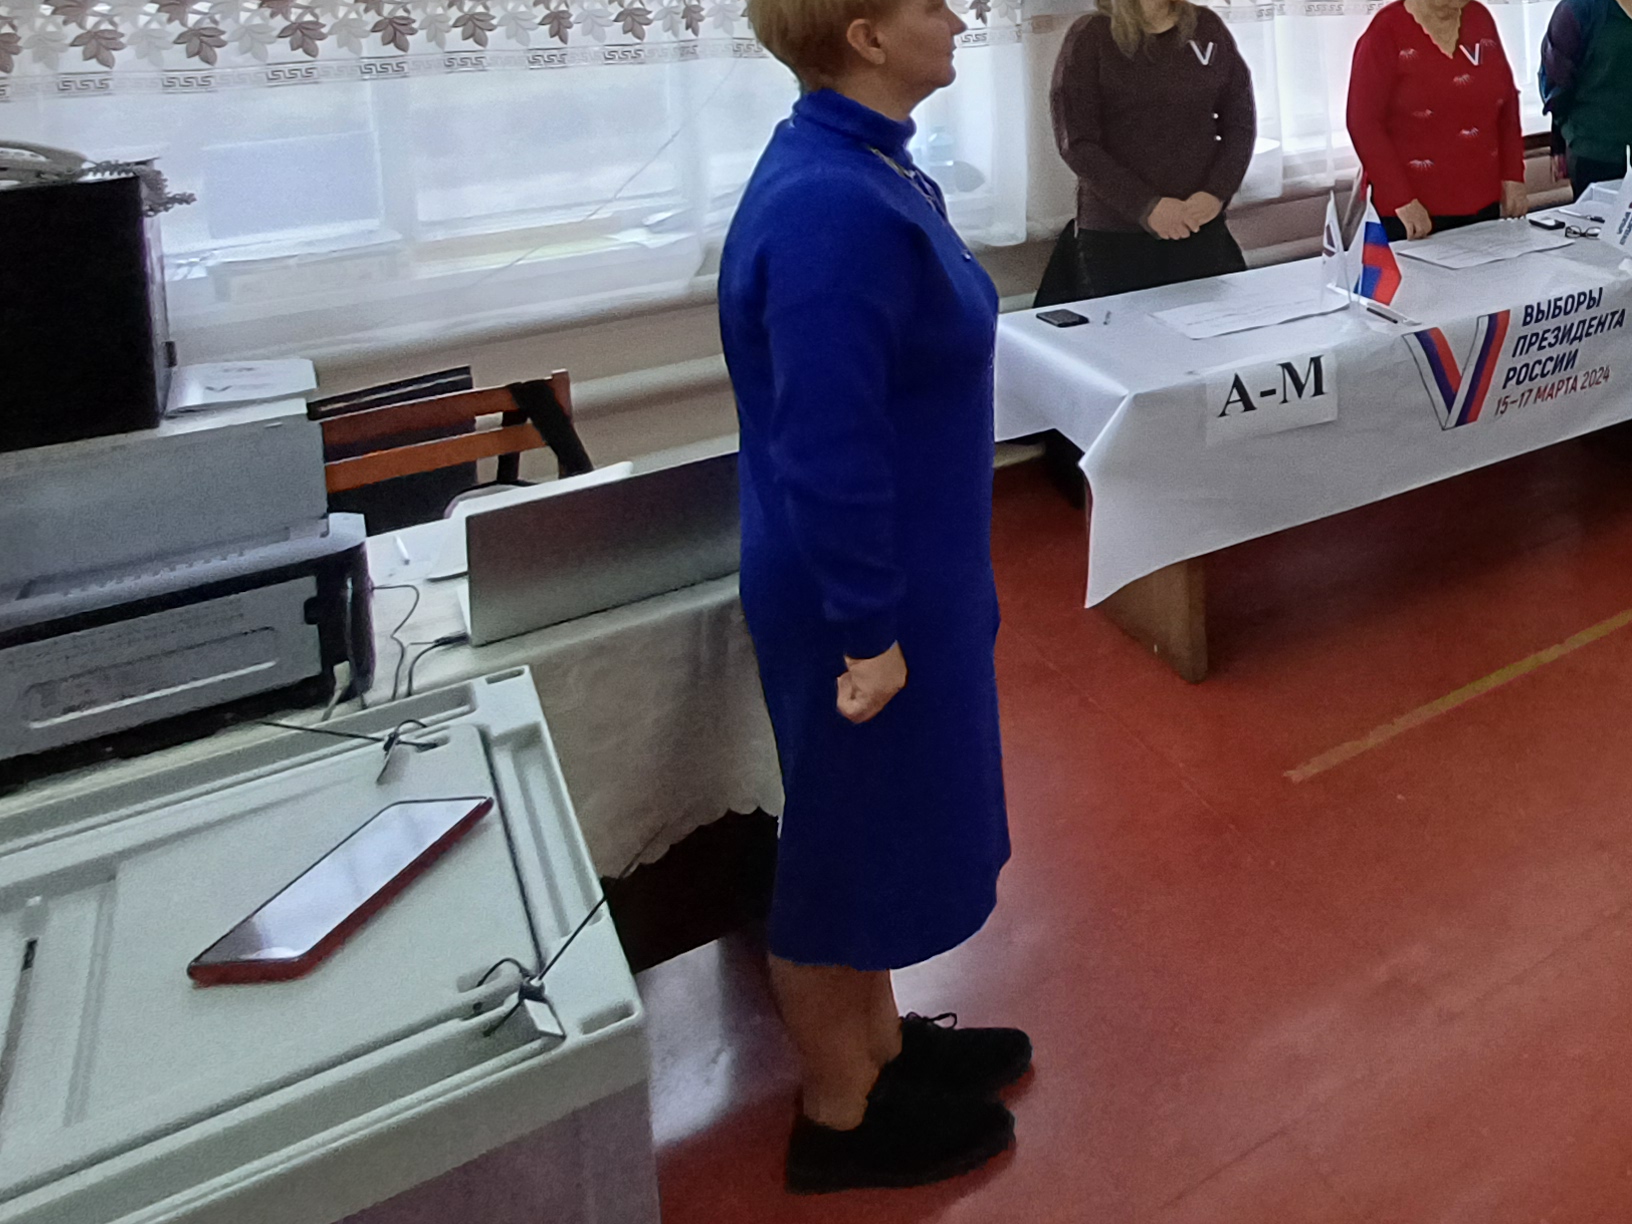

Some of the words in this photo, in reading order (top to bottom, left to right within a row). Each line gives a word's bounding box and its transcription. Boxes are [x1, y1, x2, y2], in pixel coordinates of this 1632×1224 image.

[1522, 287, 1604, 327] ВЫБОРЫ
[1511, 308, 1627, 358] ПРЕЗИДЕНТА
[1217, 354, 1327, 418] А-М
[1502, 348, 1580, 390] РОССИИ
[1533, 375, 1578, 404] МАРТА
[1580, 366, 1611, 391] 2024
